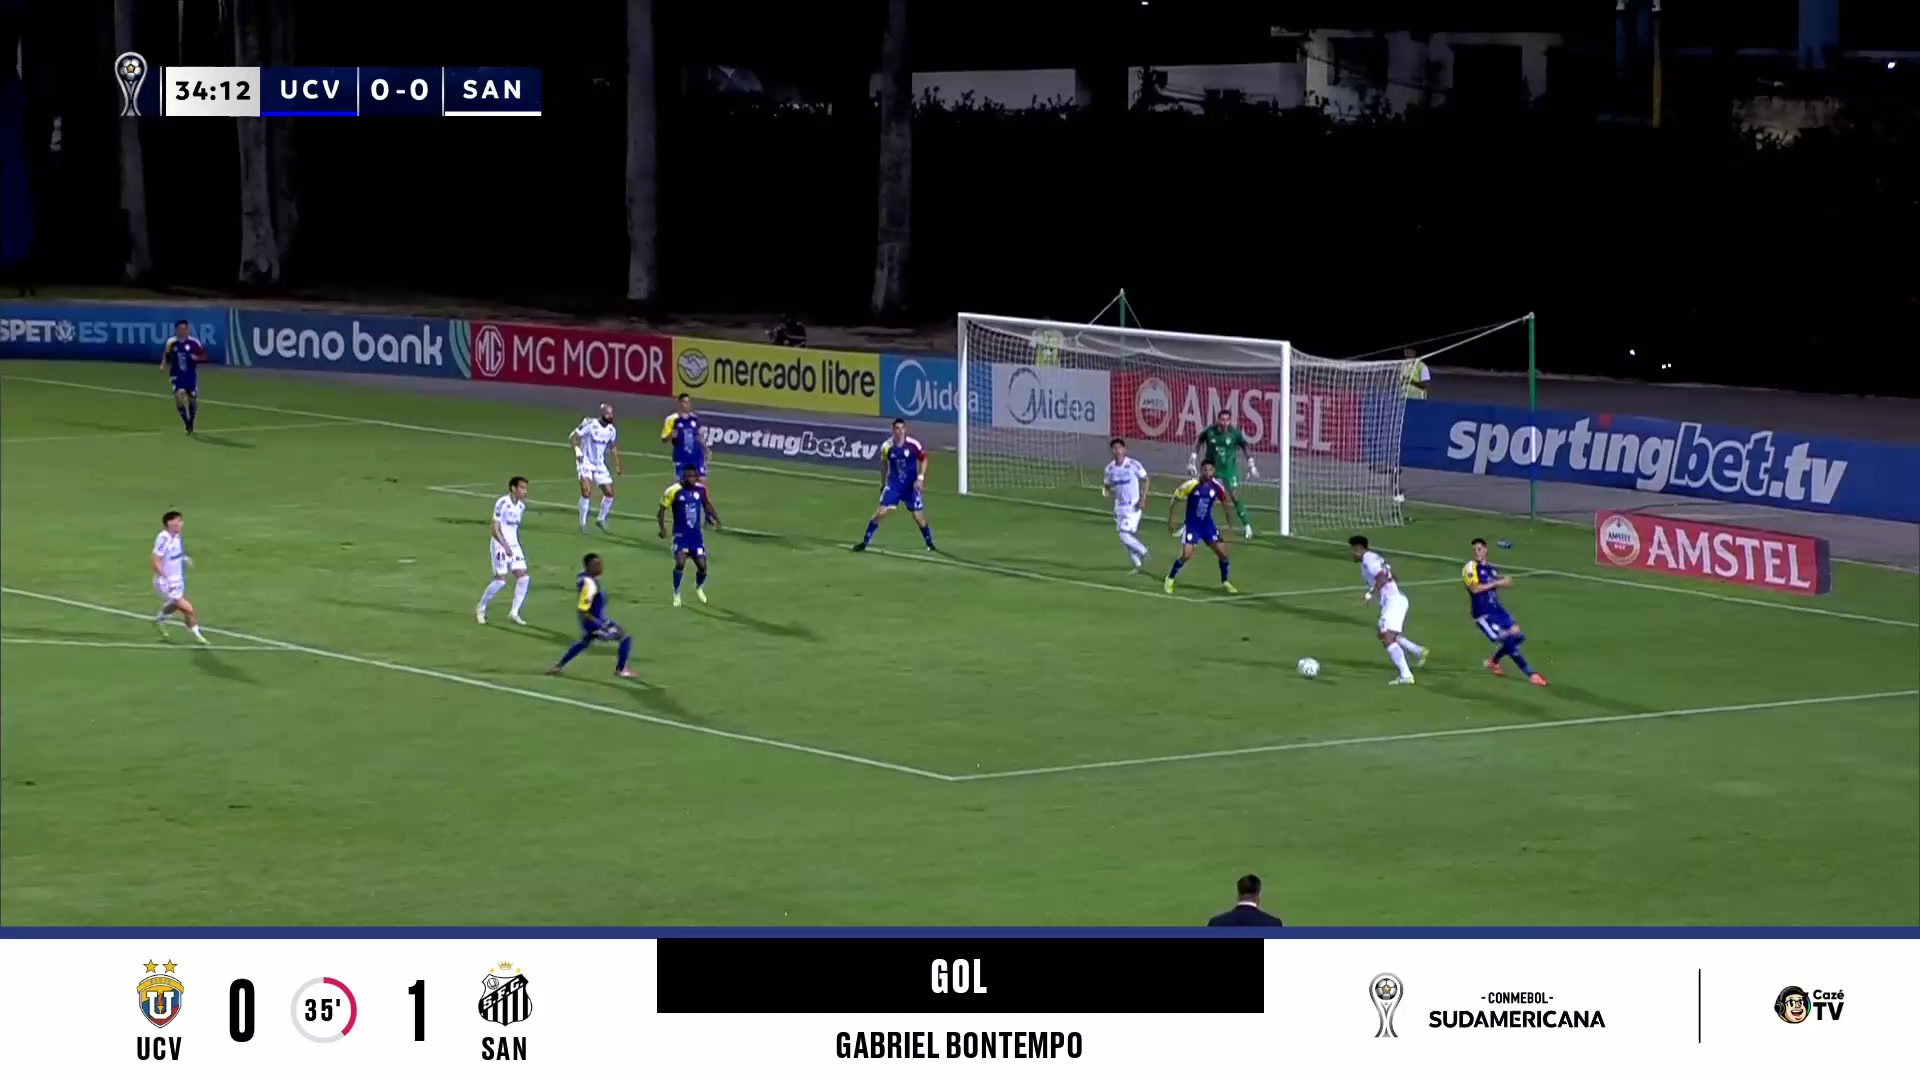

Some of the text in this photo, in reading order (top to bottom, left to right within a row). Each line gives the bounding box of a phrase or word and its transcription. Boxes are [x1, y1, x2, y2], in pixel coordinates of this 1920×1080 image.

[79, 321, 109, 343] ES
[253, 321, 443, 366] ueno bank
[478, 329, 503, 372] MG
[513, 334, 666, 384] MG MOTOR
[713, 357, 876, 397] mercado libre
[1175, 384, 1332, 451] AMSTEL
[1447, 415, 1848, 504] sportingbet.tv
[1647, 525, 1811, 589] AMSTEL
